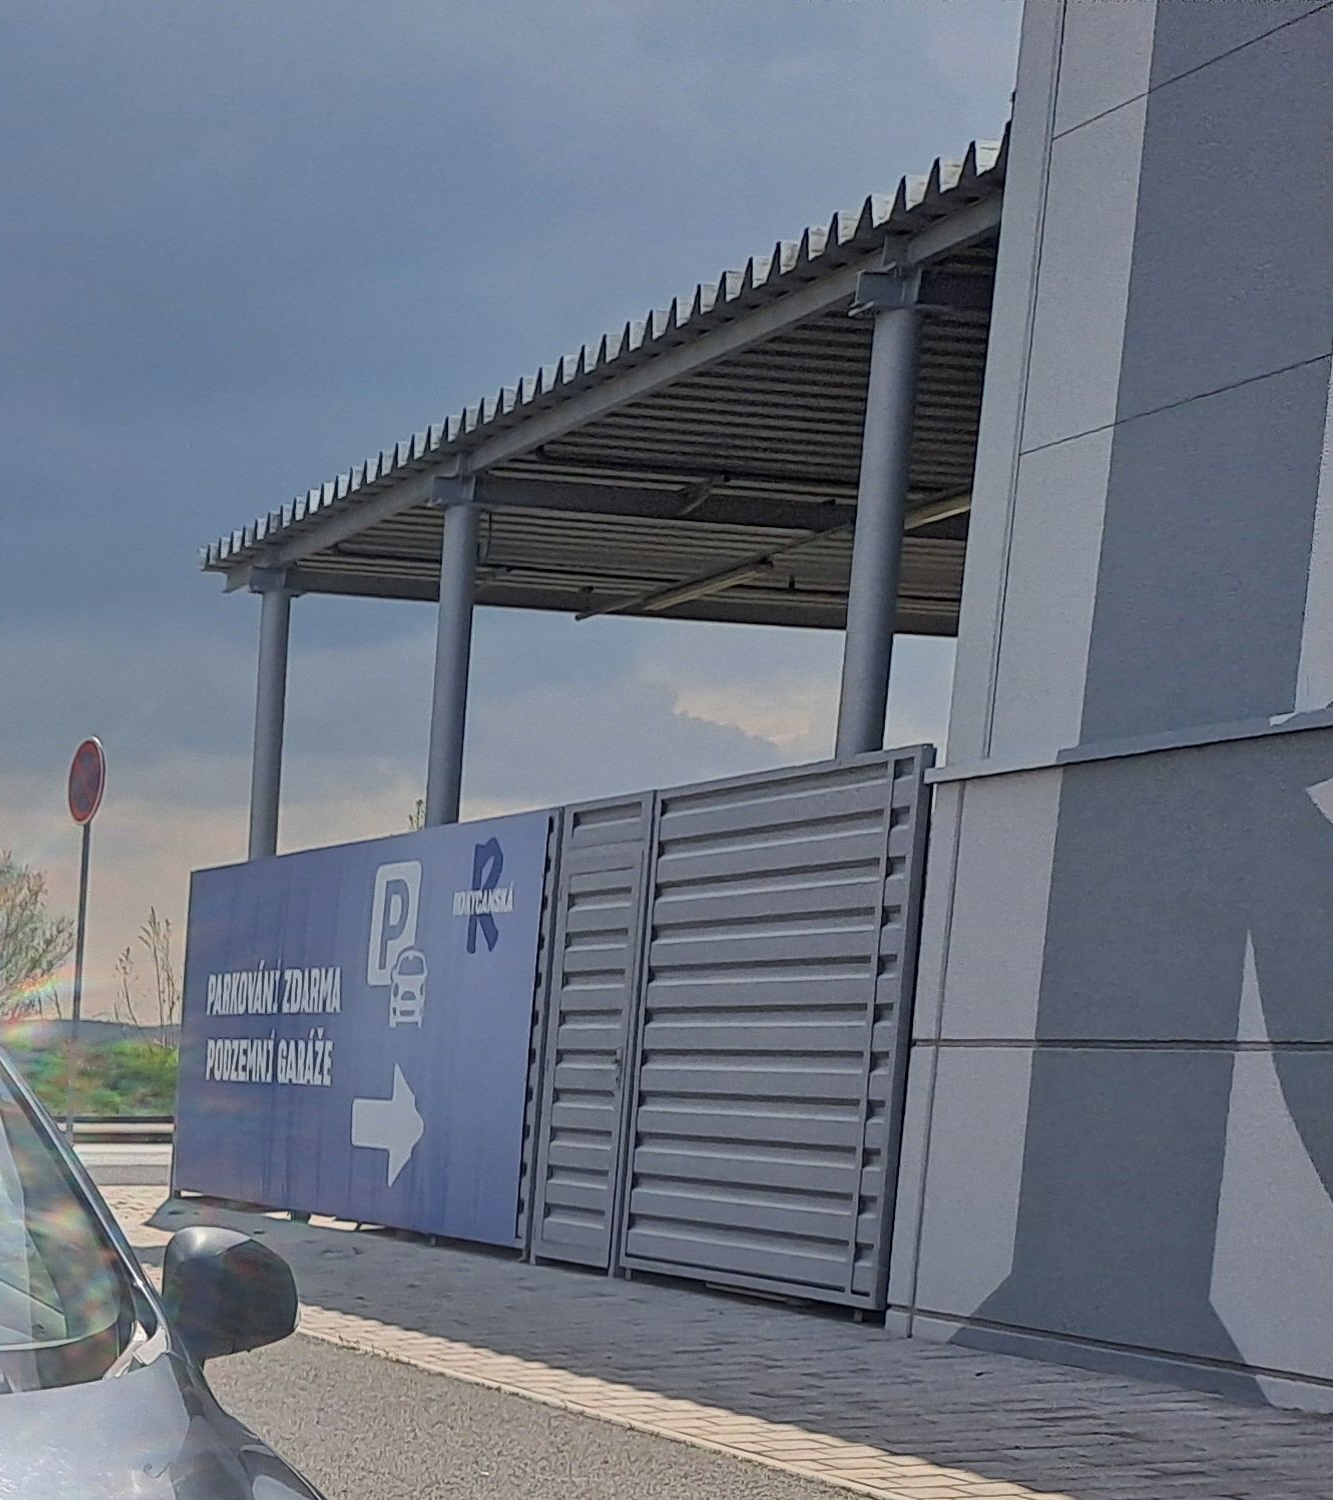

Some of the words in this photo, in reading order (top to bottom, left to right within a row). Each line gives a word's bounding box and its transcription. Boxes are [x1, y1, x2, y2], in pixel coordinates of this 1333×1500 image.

[379, 879, 410, 970] P
[206, 958, 281, 1016] PARKOVÁNÍ
[282, 967, 342, 1014] ZDARMA
[205, 1028, 276, 1083] PODZEMNÍ
[277, 1026, 334, 1086] GARÁŽE
